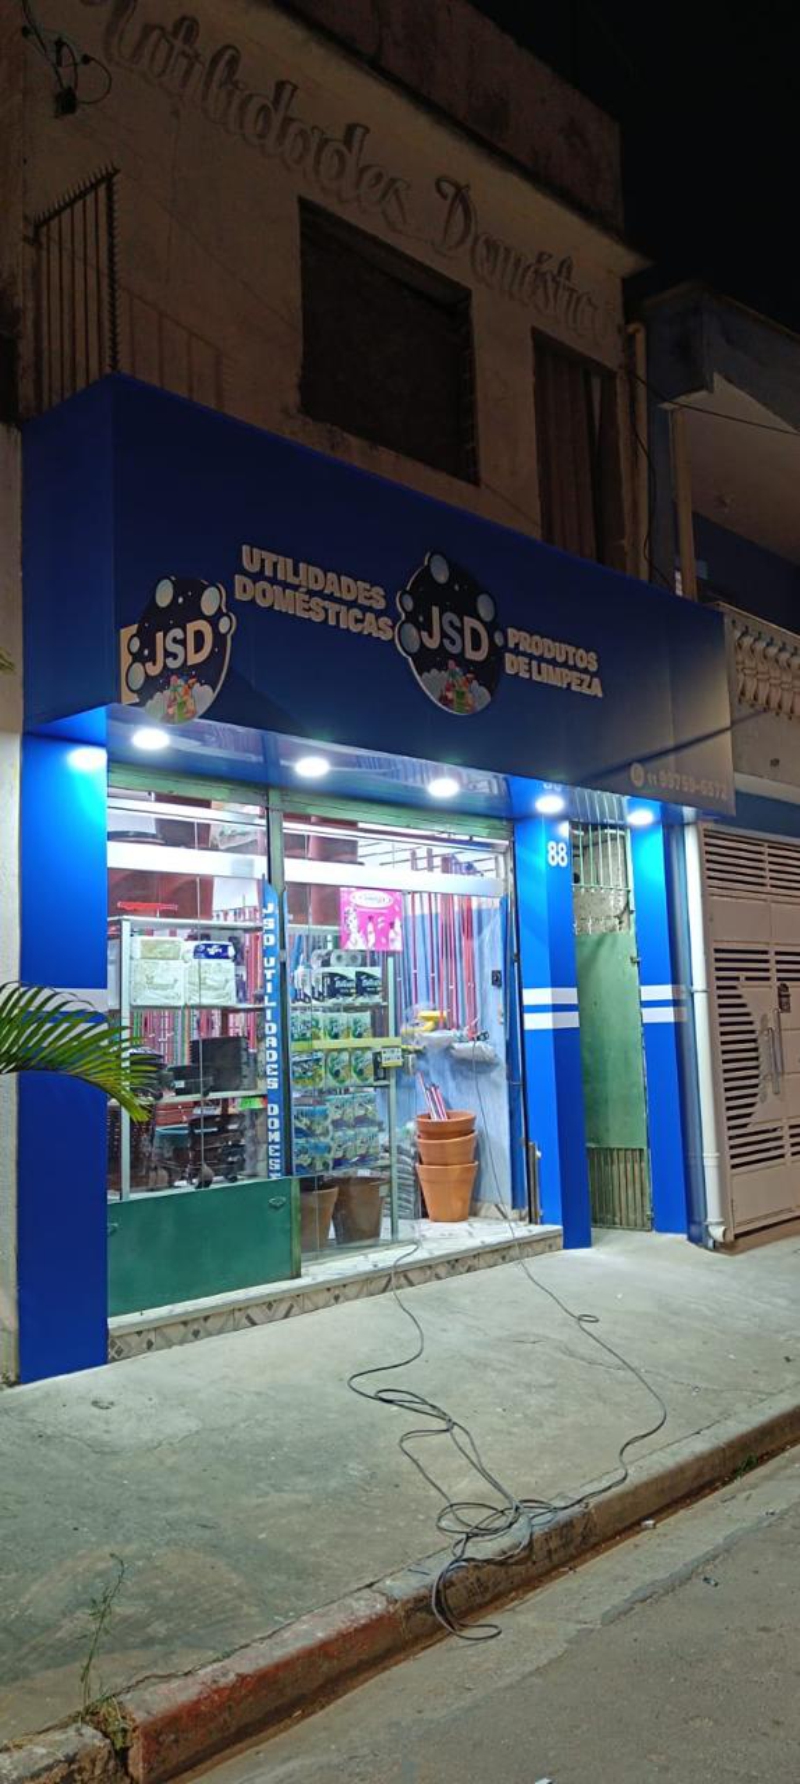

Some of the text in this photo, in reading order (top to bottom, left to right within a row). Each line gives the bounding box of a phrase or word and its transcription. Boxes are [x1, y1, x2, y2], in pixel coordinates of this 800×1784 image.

[241, 545, 386, 610] UTILIDADES
[234, 574, 393, 641] DOMÉSTICAS
[420, 605, 489, 662] JSD
[145, 619, 214, 677] JSD
[504, 652, 603, 698] DE LIMPEZA
[507, 627, 598, 672] PRODUTOS
[547, 841, 568, 867] 88
[264, 956, 279, 1090] UTILIDADES
